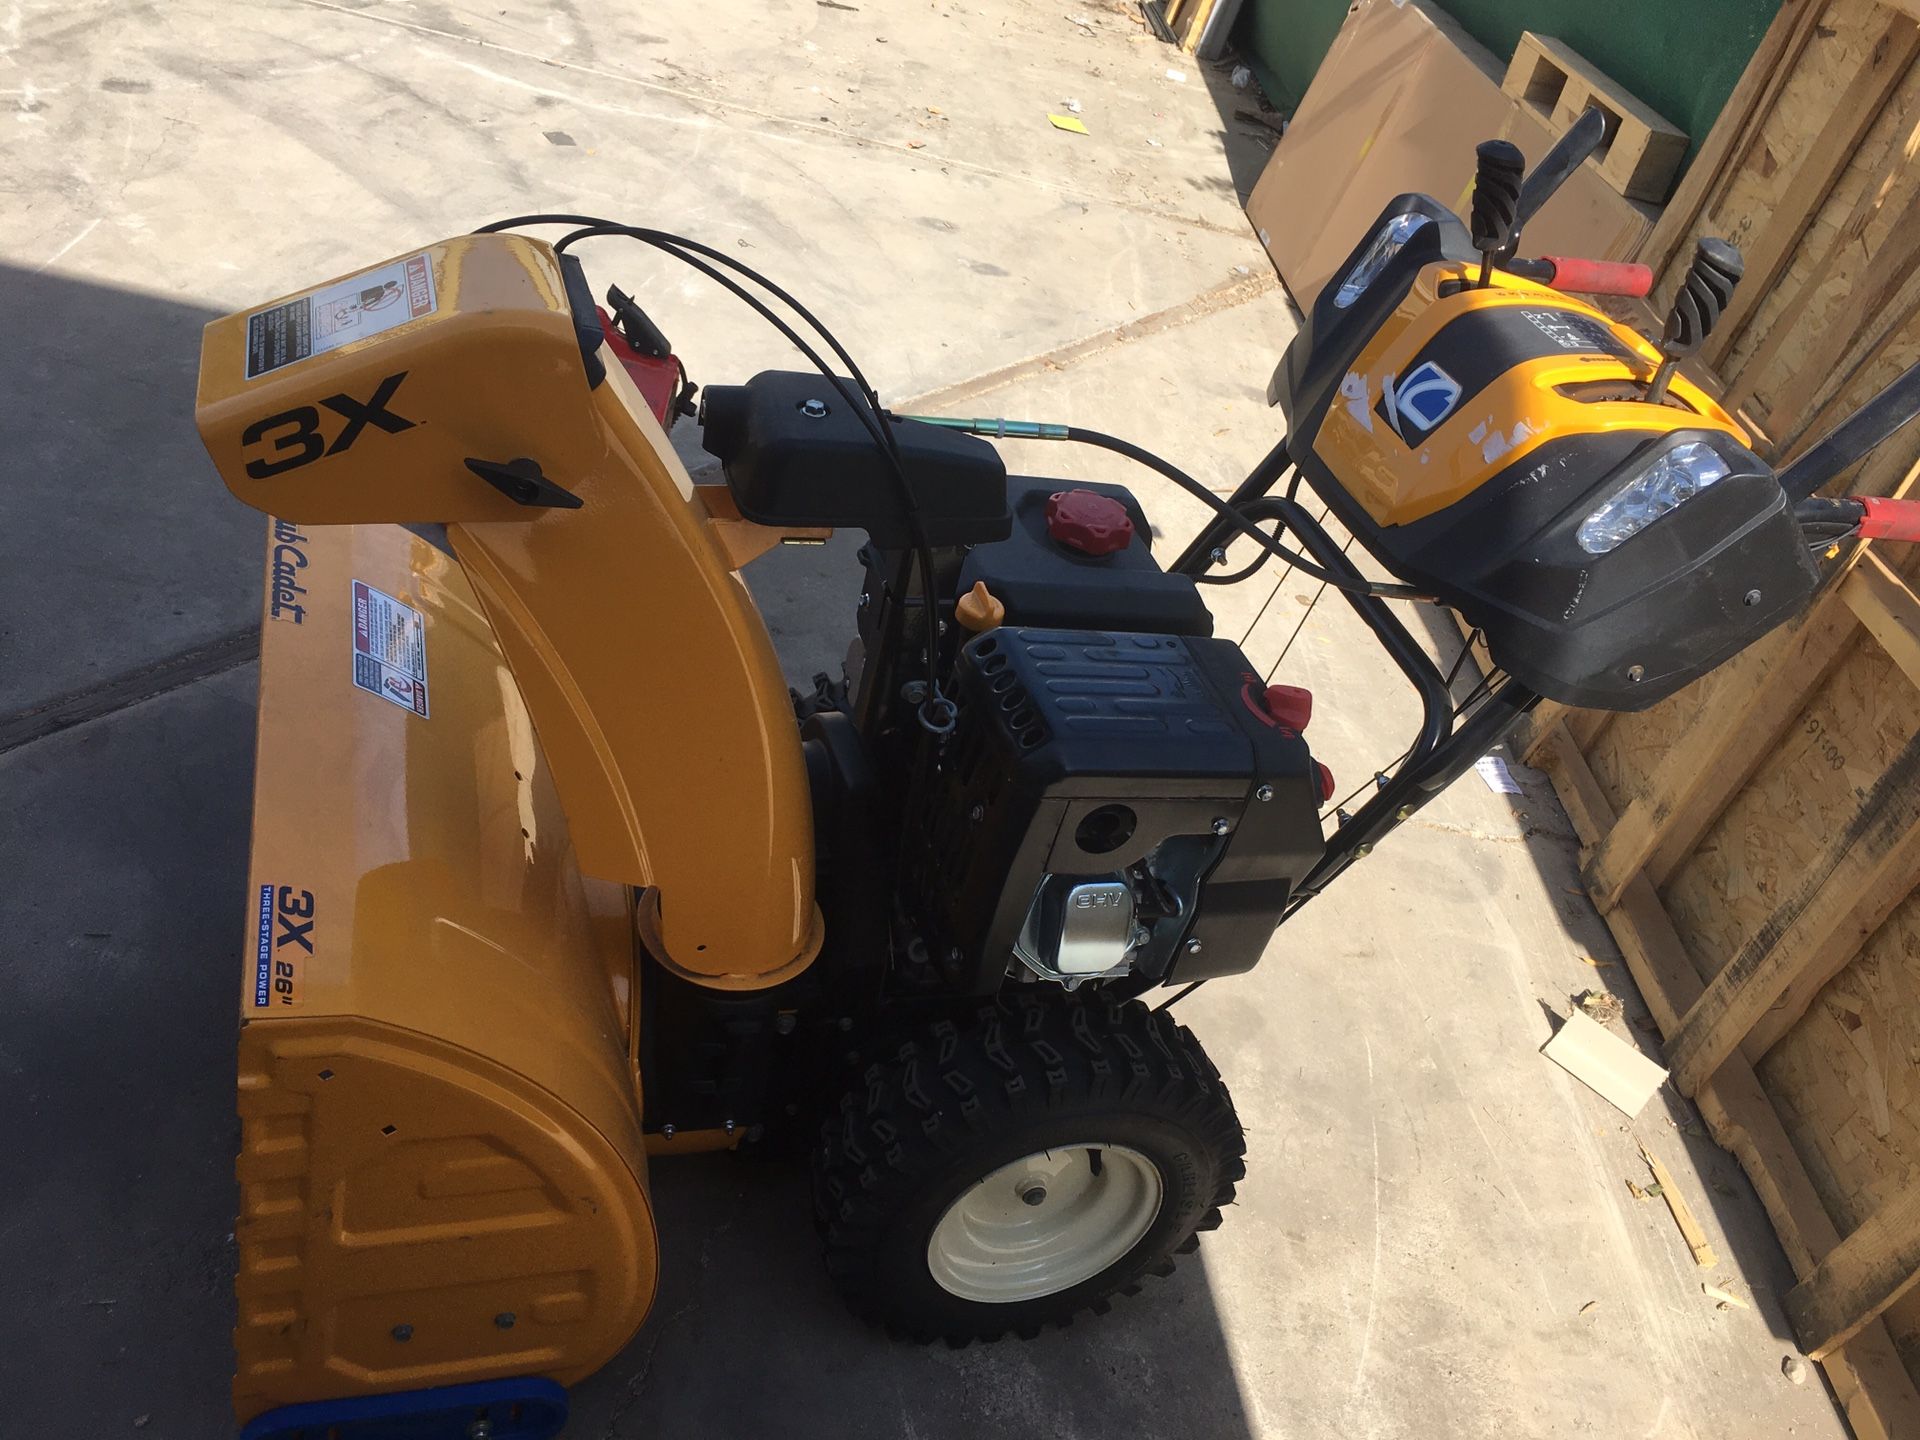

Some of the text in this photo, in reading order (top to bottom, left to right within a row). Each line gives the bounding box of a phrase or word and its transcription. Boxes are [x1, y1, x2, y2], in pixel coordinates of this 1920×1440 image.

[410, 273, 431, 314] DANGER
[242, 370, 417, 479] 3X
[271, 518, 309, 625] ub Cadet
[357, 597, 369, 631] DANGER
[277, 886, 314, 954] 3X
[1076, 892, 1123, 909] OHV
[257, 886, 272, 1005] THREE-STAGE POWER
